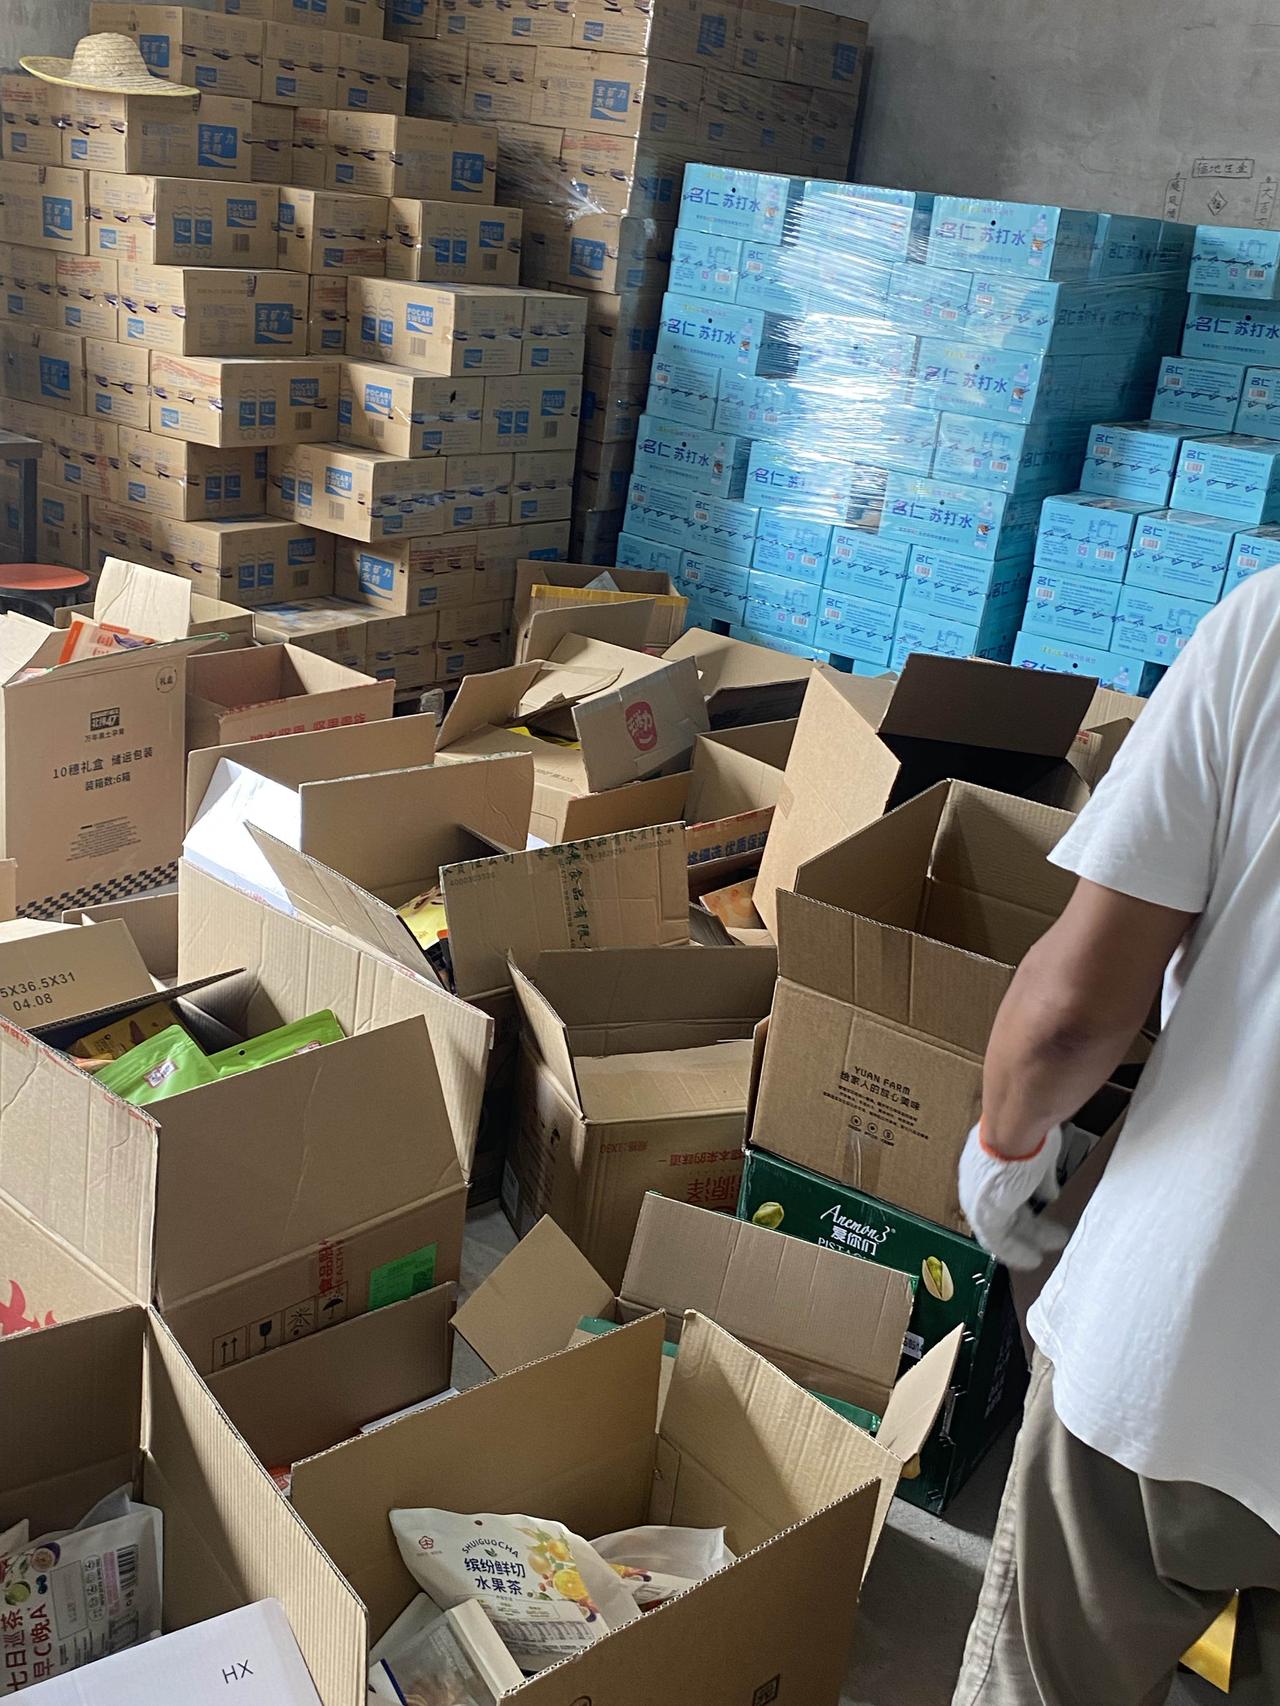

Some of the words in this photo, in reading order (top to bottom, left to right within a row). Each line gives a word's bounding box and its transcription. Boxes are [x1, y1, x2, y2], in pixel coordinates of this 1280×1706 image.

[406, 306, 433, 318] POCARI
[406, 315, 431, 326] SWEAT
[0, 970, 77, 1000] 5X36.5X31
[13, 993, 54, 1012] 04.08
[854, 1065, 881, 1083] YUAN
[882, 1078, 911, 1096] FARM
[831, 1225, 878, 1257] 爱你们
[464, 1557, 526, 1578] 缤纷鲜切
[475, 1576, 523, 1596] 水果茶
[31, 1603, 54, 1678] 早C晚A
[221, 1659, 255, 1684] HX
